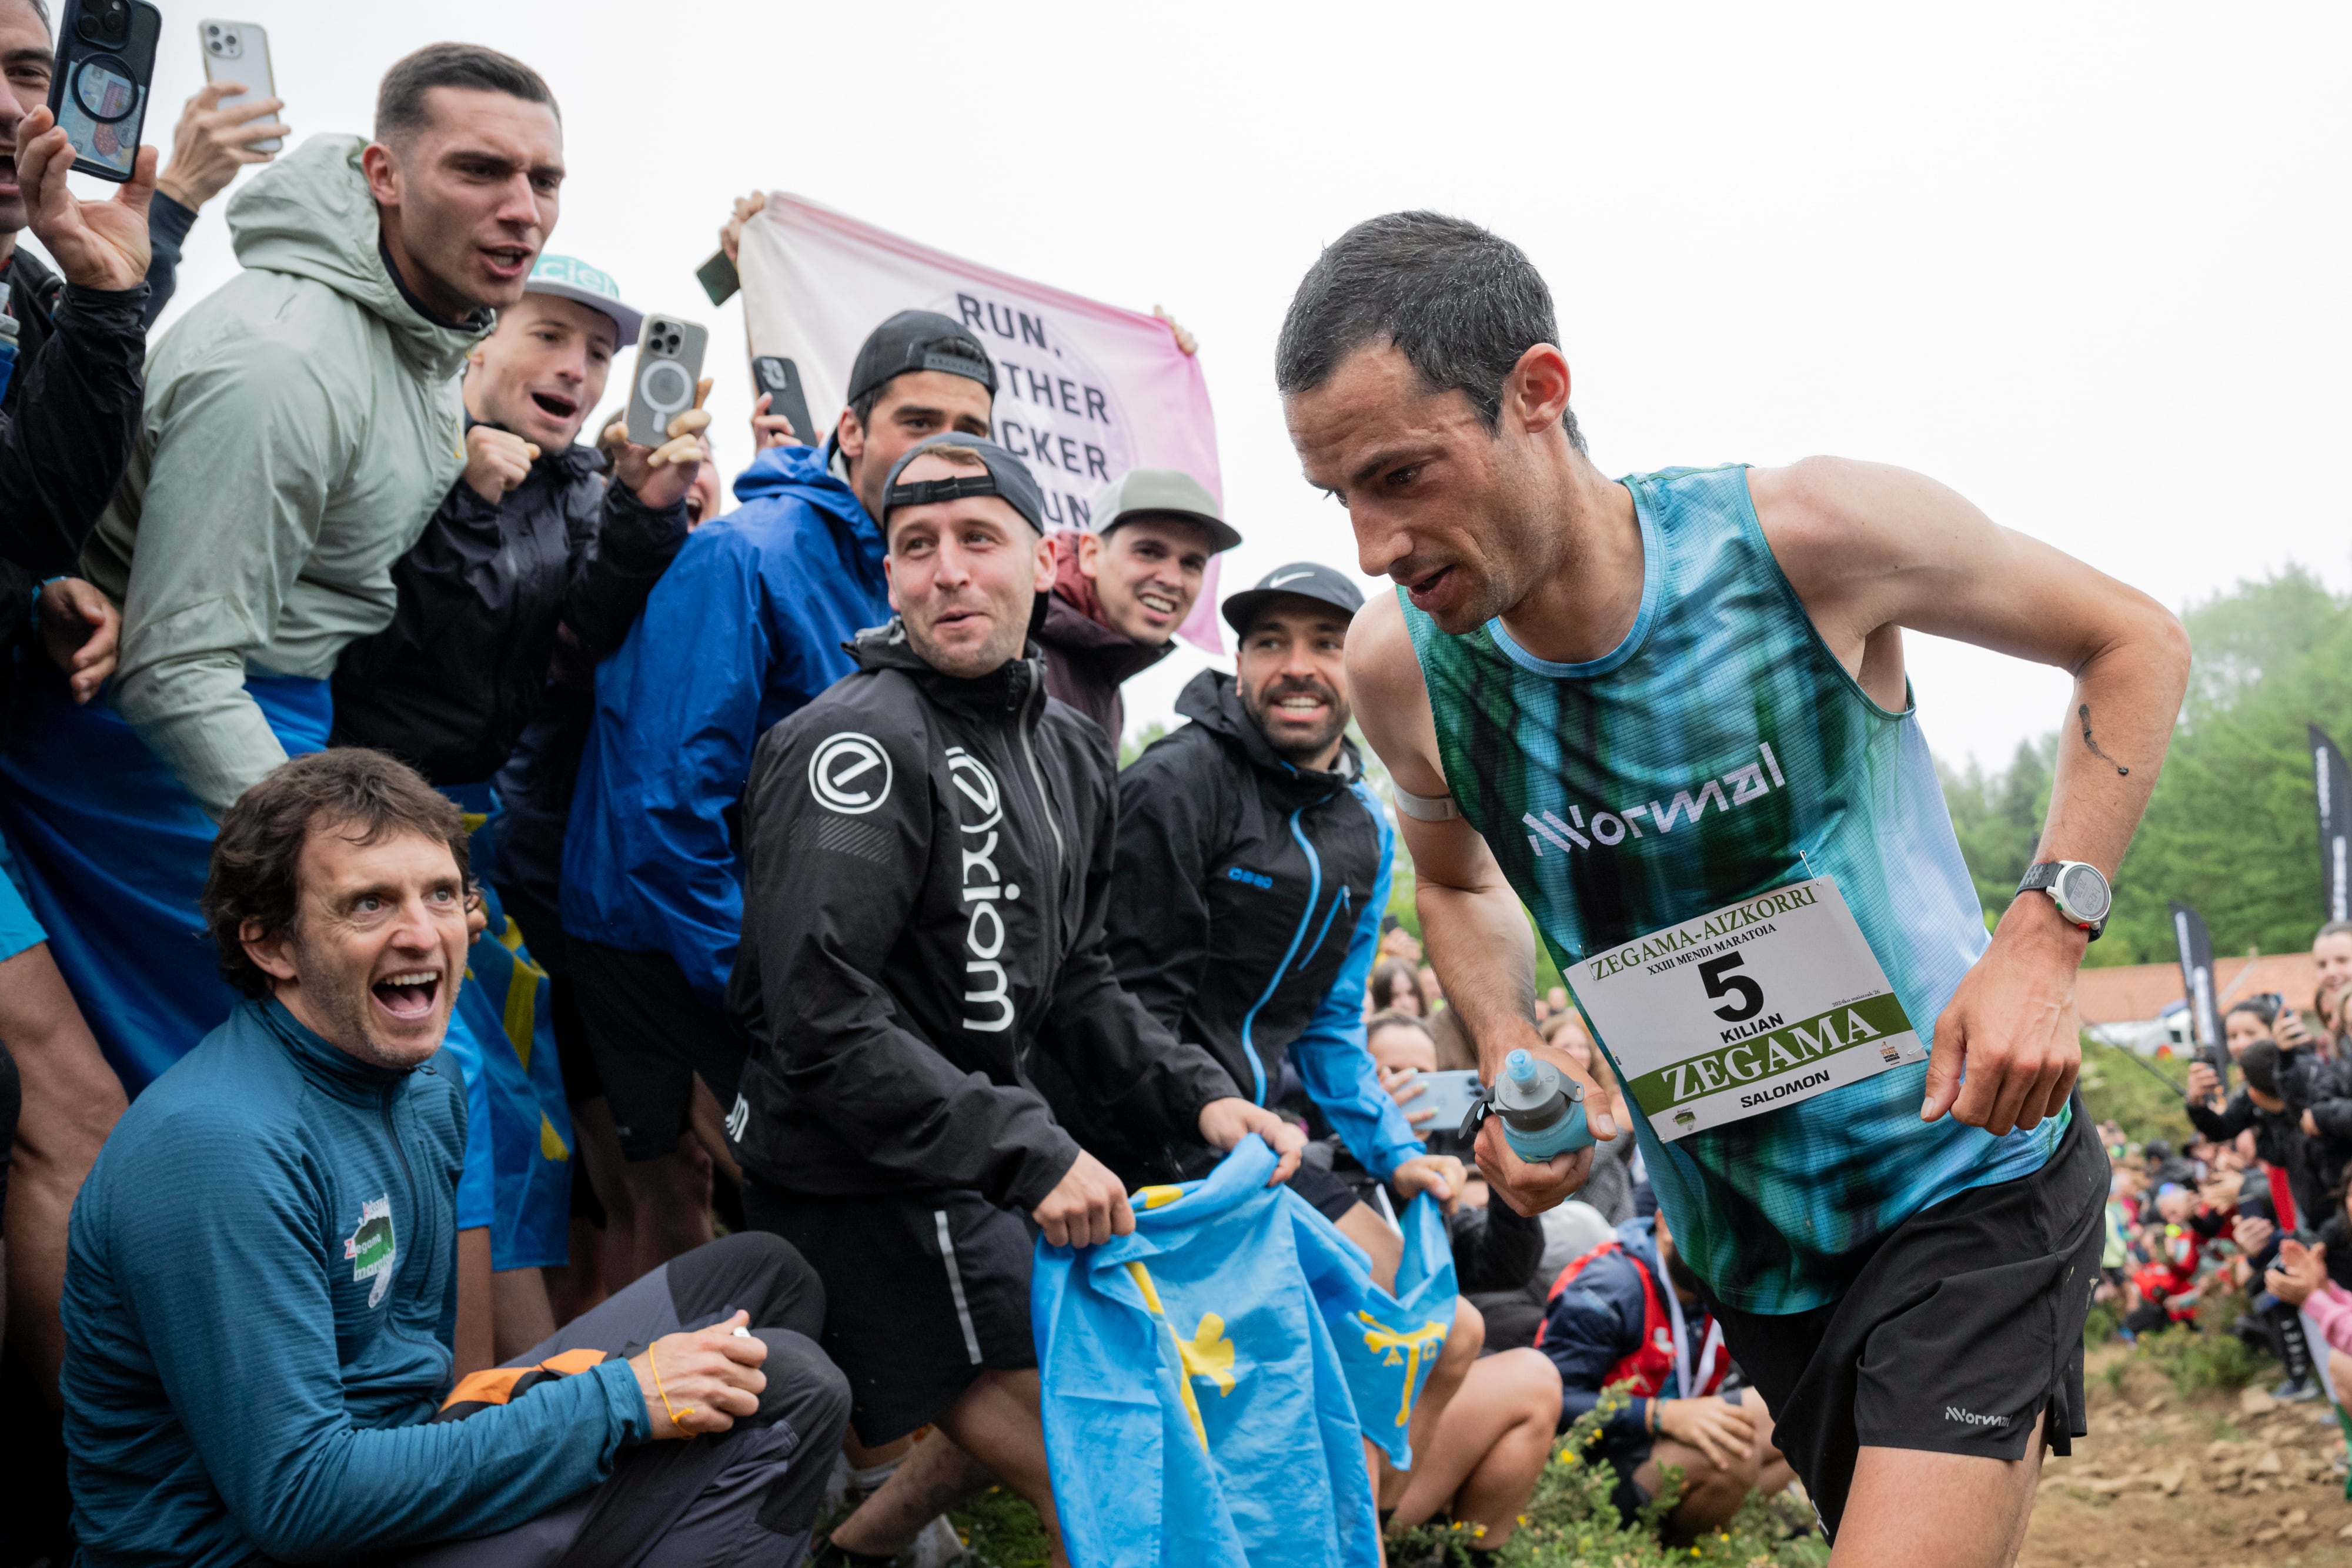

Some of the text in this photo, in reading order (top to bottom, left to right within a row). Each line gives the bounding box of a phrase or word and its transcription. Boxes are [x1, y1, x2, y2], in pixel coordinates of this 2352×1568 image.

[539, 258, 619, 296] ciel
[1000, 360, 1110, 425] THER
[1001, 420, 1110, 483] CKER
[1590, 885, 1819, 981] ZEGAMA-AIZKORRI
[1646, 923, 1778, 976] XXIII MENDI MARATOIA
[1698, 950, 1765, 1023] 5
[1831, 998, 1851, 1008] 2024ko
[1852, 991, 1873, 1001] maiatzak
[1661, 1008, 1881, 1102] ZEGAMA
[1719, 1012, 1785, 1044] KILIAN
[1740, 1069, 1831, 1109] SALOMON
